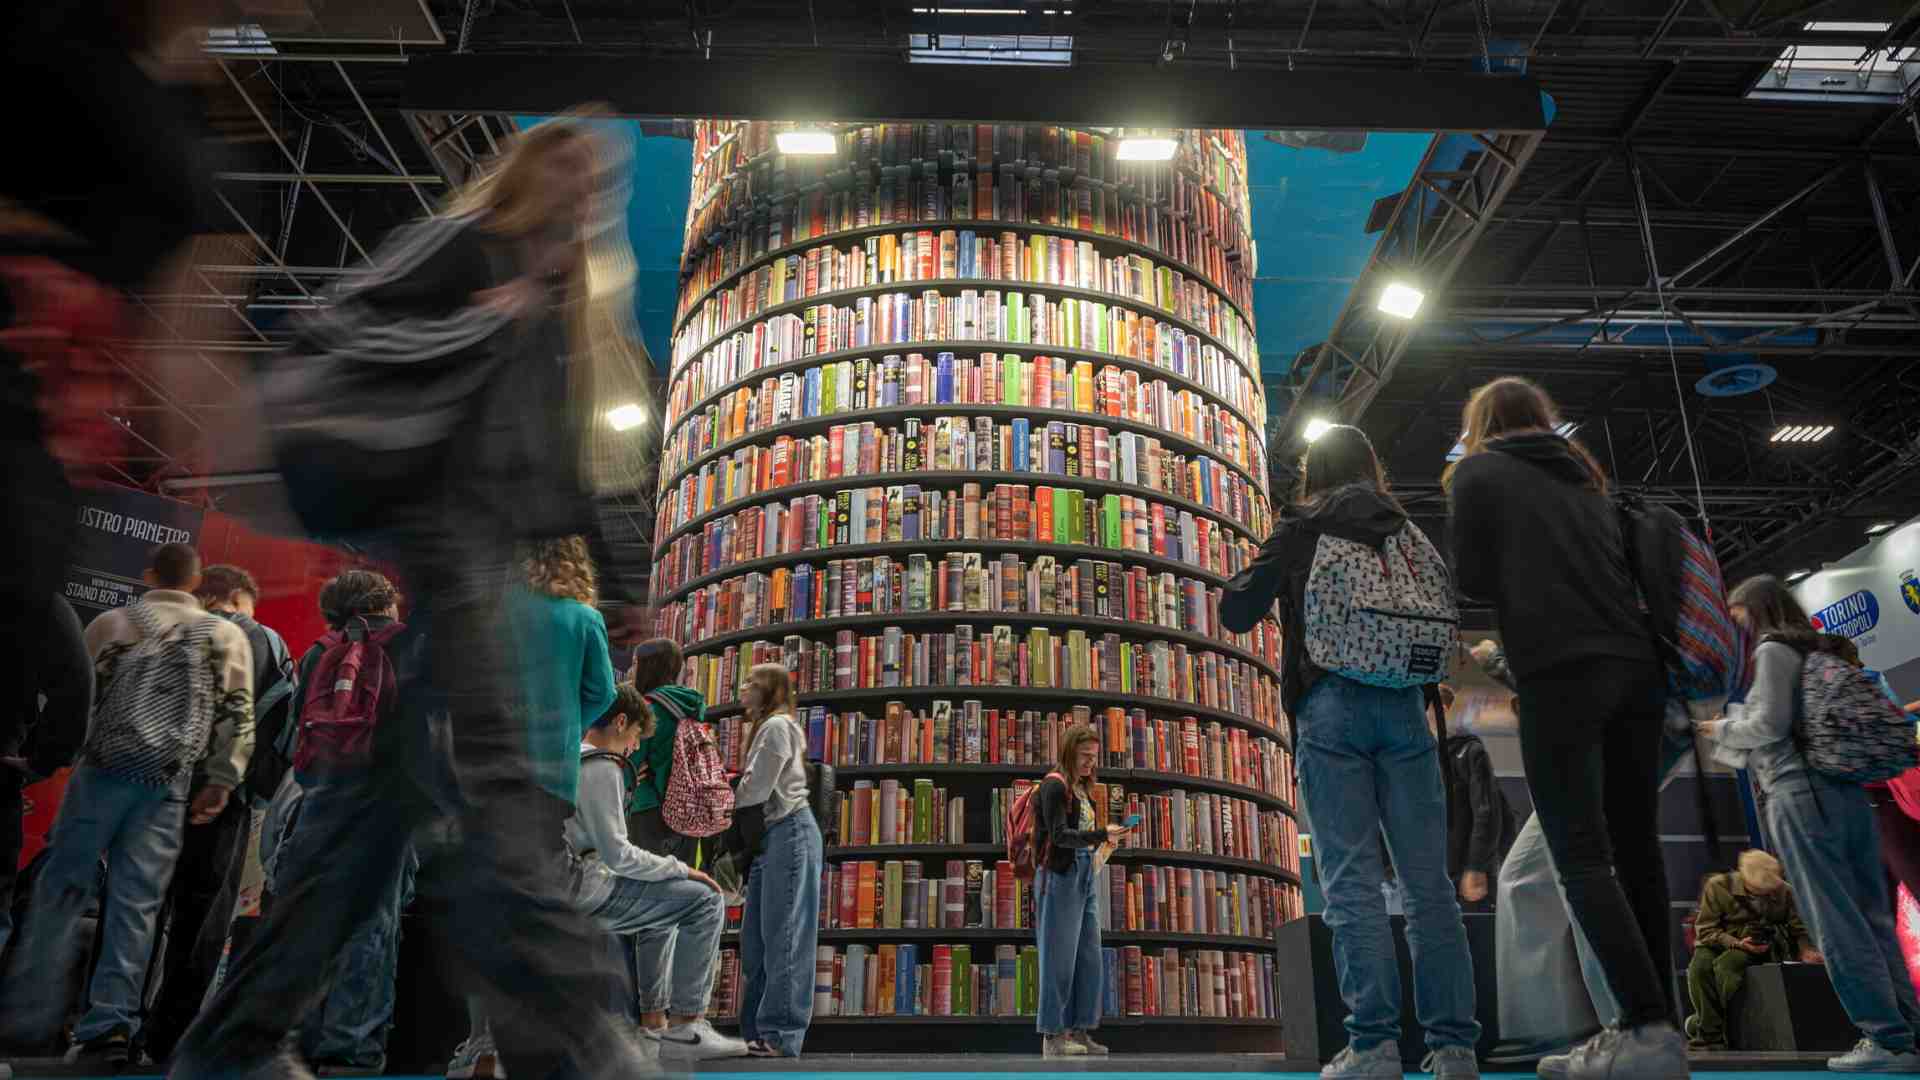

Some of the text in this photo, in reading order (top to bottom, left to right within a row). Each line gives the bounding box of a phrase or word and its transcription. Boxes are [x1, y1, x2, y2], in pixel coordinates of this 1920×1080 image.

[65, 582, 98, 601] STAND
[1822, 592, 1867, 629] TORINO
[1826, 612, 1872, 639] ETROPOLI
